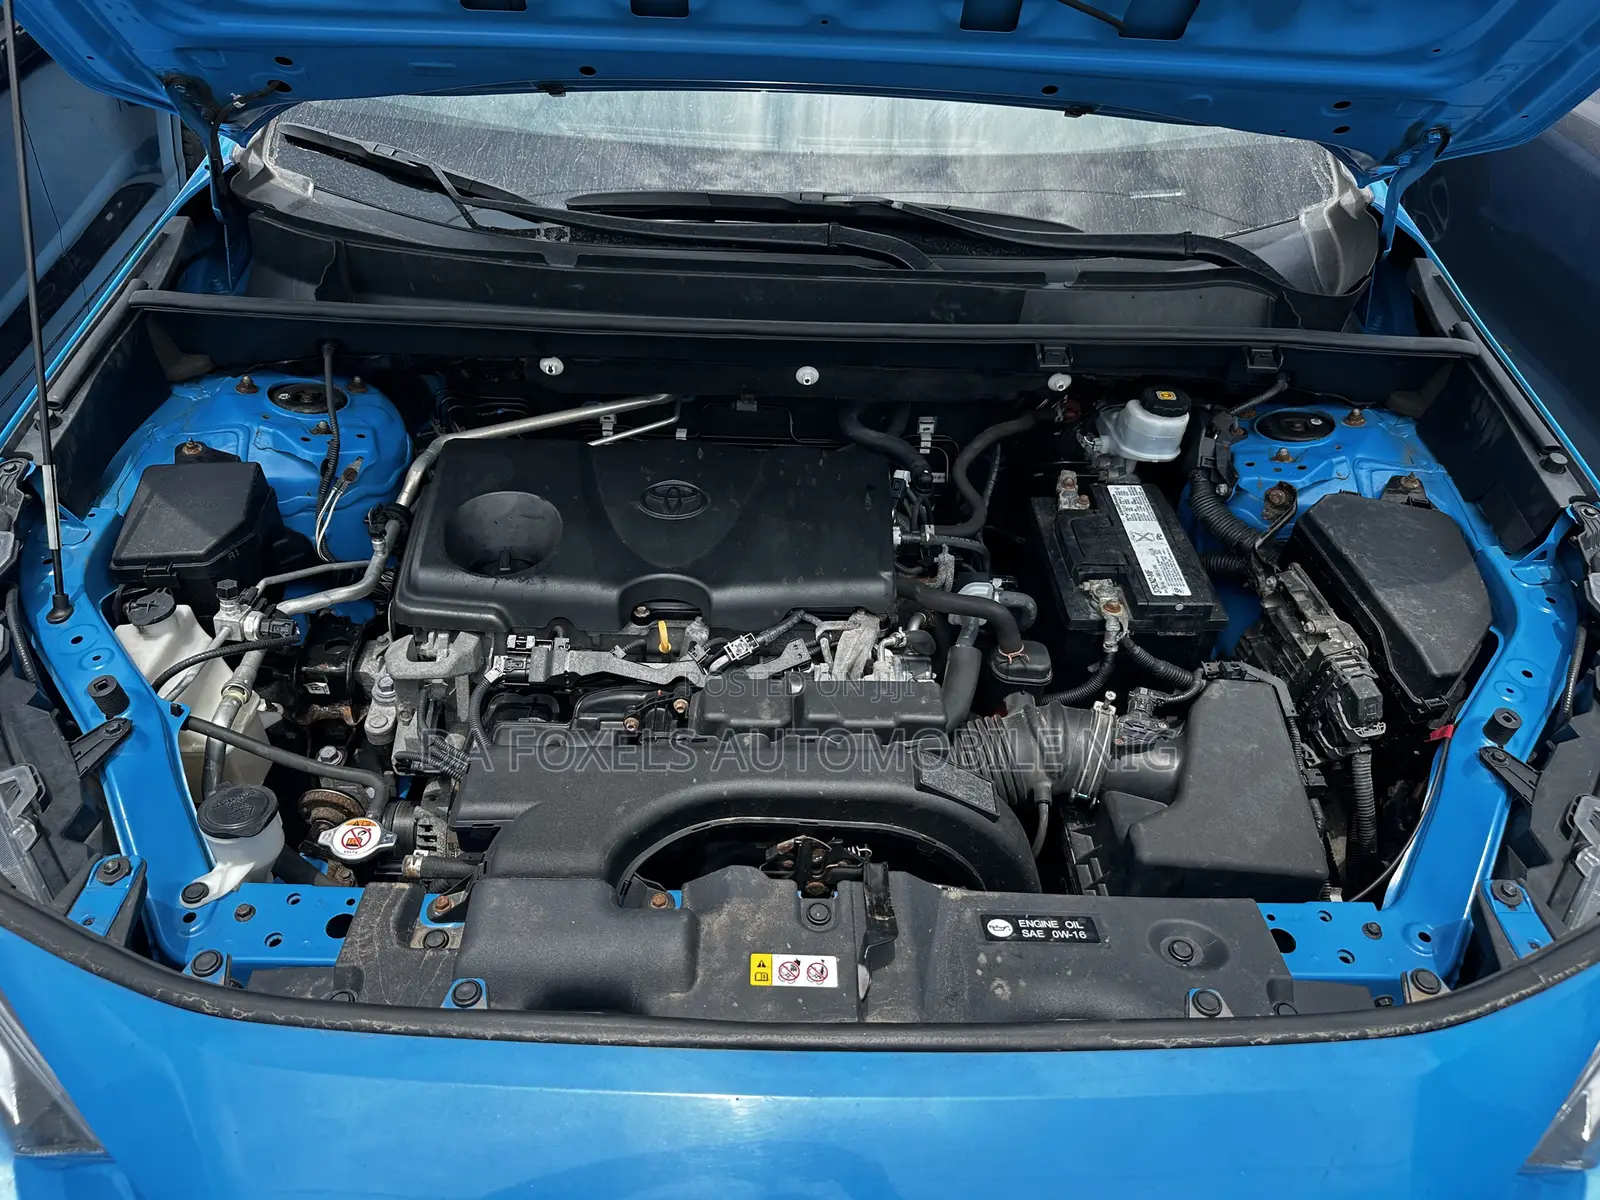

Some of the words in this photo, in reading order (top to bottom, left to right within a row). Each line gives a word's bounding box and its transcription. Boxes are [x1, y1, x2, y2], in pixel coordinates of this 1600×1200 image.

[1018, 919, 1059, 928] ENGINE
[1064, 920, 1084, 929] OIL
[1021, 929, 1045, 939] SAE
[1051, 930, 1087, 940] 0W-16
